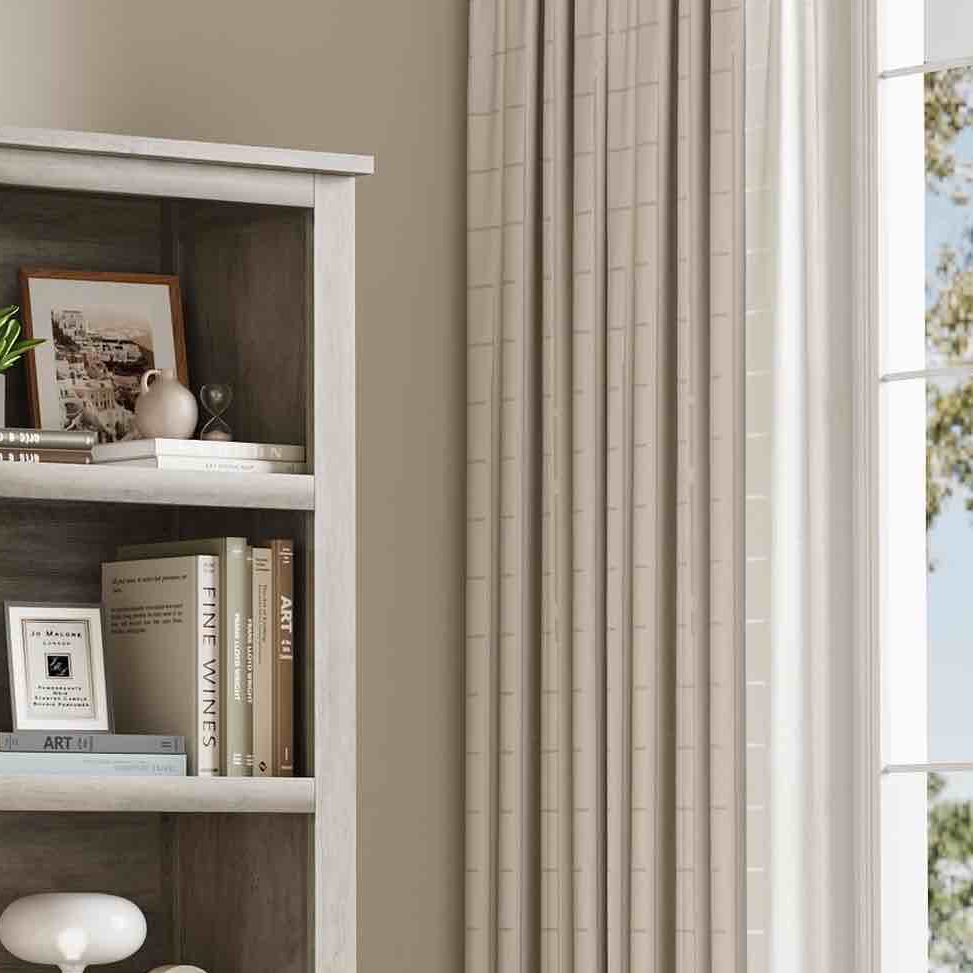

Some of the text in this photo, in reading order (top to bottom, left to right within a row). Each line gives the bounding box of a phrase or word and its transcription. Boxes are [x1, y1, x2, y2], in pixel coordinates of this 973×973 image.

[203, 587, 216, 646] FINE
[281, 595, 292, 632] ART
[47, 630, 82, 638] MALONE
[203, 657, 216, 748] WINES
[43, 736, 73, 750] ART
